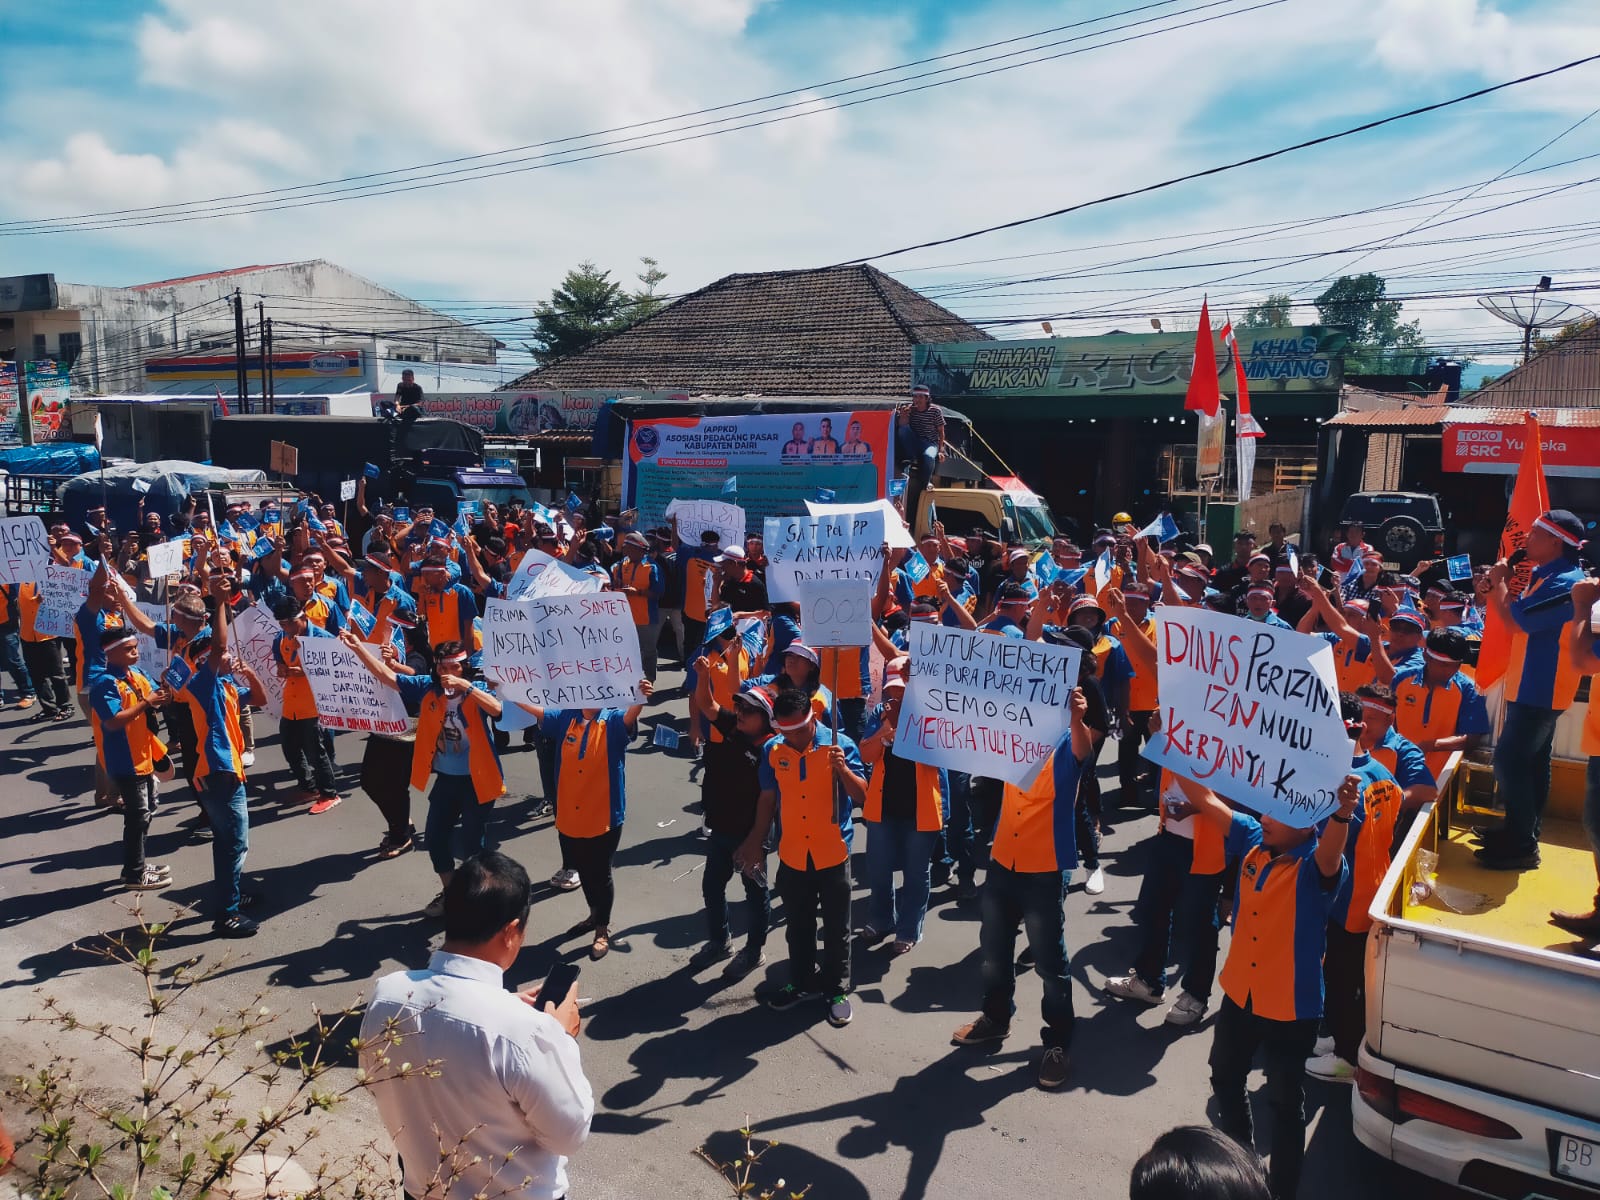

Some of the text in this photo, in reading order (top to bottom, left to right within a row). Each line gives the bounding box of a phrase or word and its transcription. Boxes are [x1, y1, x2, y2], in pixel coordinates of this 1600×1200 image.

[974, 347, 1056, 369] RUMAH
[1251, 337, 1317, 357] KHAS
[969, 367, 1049, 389] MAKAN
[684, 441, 757, 450] KABUPATEN DAIRI
[703, 434, 748, 442] PEDAGANG
[749, 433, 779, 441] PASAR
[1463, 431, 1499, 441] TOKO
[1505, 438, 1567, 452] Yueka
[1470, 445, 1501, 457] SRC
[786, 523, 819, 543] SAT
[853, 520, 868, 536] PP
[795, 545, 885, 562] ANTARA ADA
[488, 599, 627, 624] TERIMA JASA SANTET
[492, 626, 624, 657] INSTANSI YANG
[1164, 621, 1243, 686] DINAS
[302, 641, 358, 668] LEBIH BAIK
[919, 630, 1070, 684] UNTUK MEREKA
[491, 654, 633, 684] TIDAK BEKERJA
[907, 658, 940, 678] YANG
[945, 663, 979, 688] PURA
[984, 670, 1023, 697] PURA
[925, 688, 1033, 727] SEMOGA
[1204, 684, 1260, 729] IZIN
[903, 713, 977, 751] MEREKA
[1566, 1139, 1593, 1167] BB
